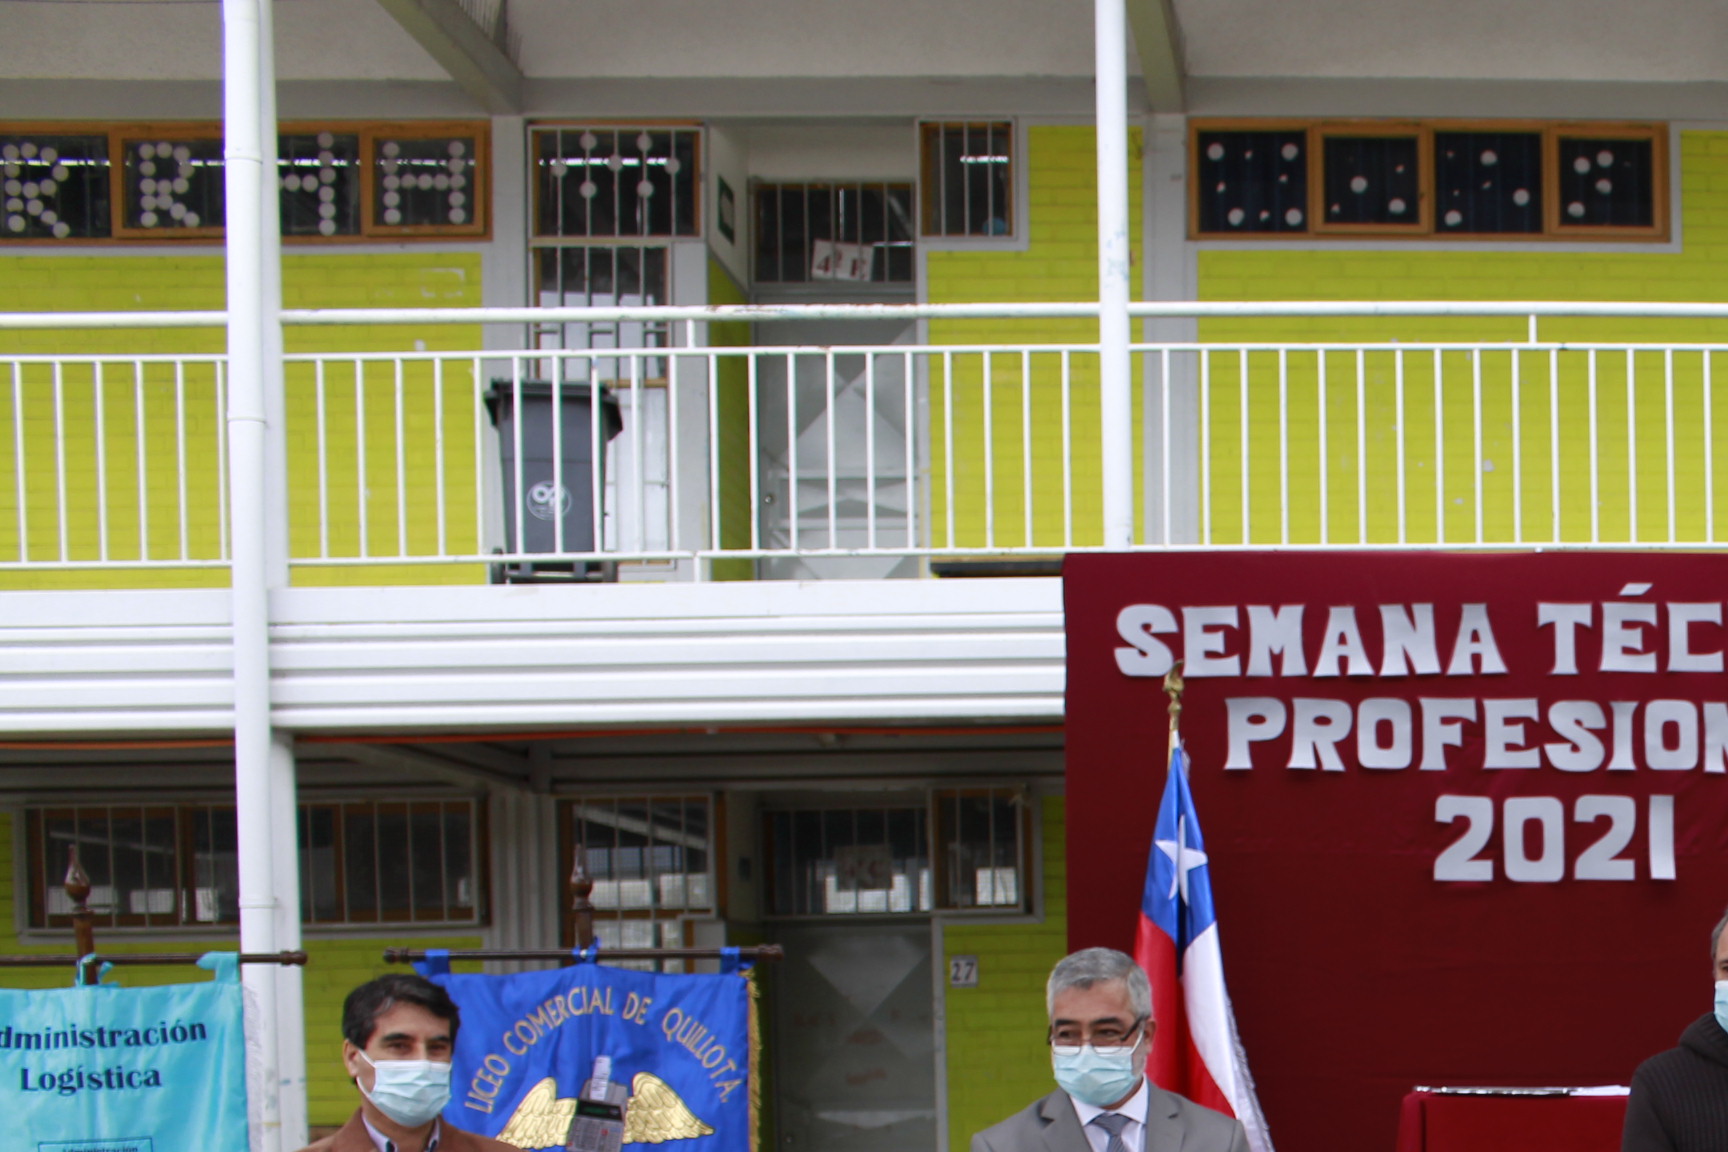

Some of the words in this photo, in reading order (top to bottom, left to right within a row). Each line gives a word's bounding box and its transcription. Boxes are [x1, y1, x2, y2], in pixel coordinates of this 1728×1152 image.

[1113, 603, 1509, 678] SEMANA
[1433, 793, 1677, 882] 2021
[952, 962, 975, 982] 27
[0, 1020, 207, 1051] dministración
[464, 1053, 511, 1114] LICEO
[503, 985, 615, 1056] COMERCIAL
[622, 991, 653, 1025] DE
[20, 1065, 162, 1096] Logística
